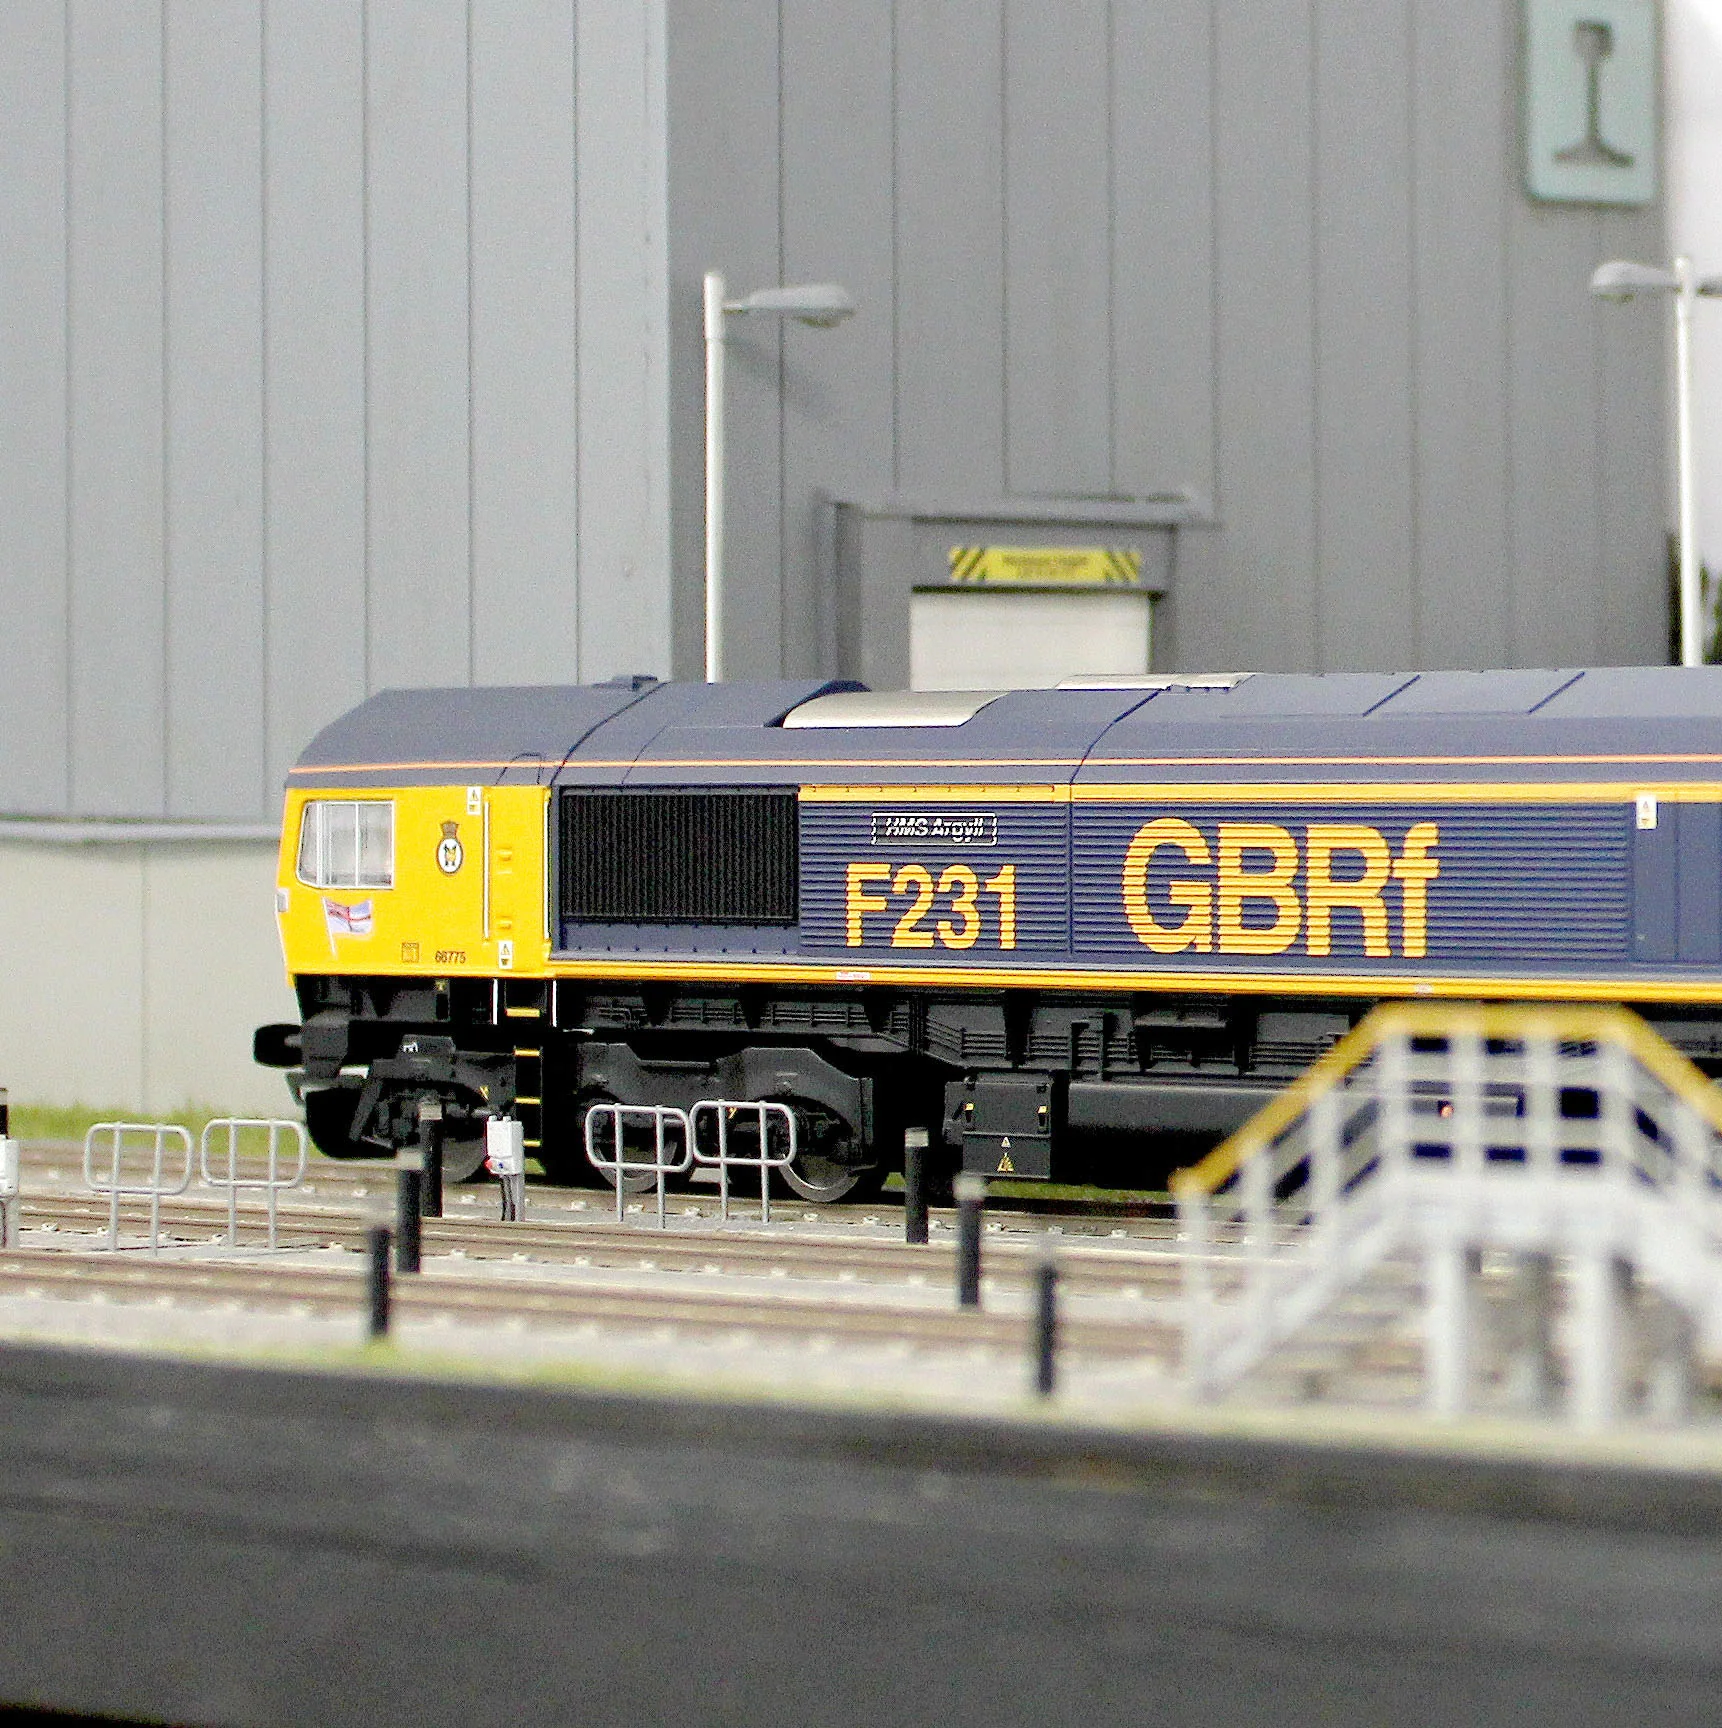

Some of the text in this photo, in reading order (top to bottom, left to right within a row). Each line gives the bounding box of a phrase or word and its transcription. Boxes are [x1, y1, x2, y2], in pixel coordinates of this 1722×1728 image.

[885, 817, 984, 843] HMS Argyll
[845, 862, 1016, 951] F231
[1122, 816, 1441, 959] GBRf
